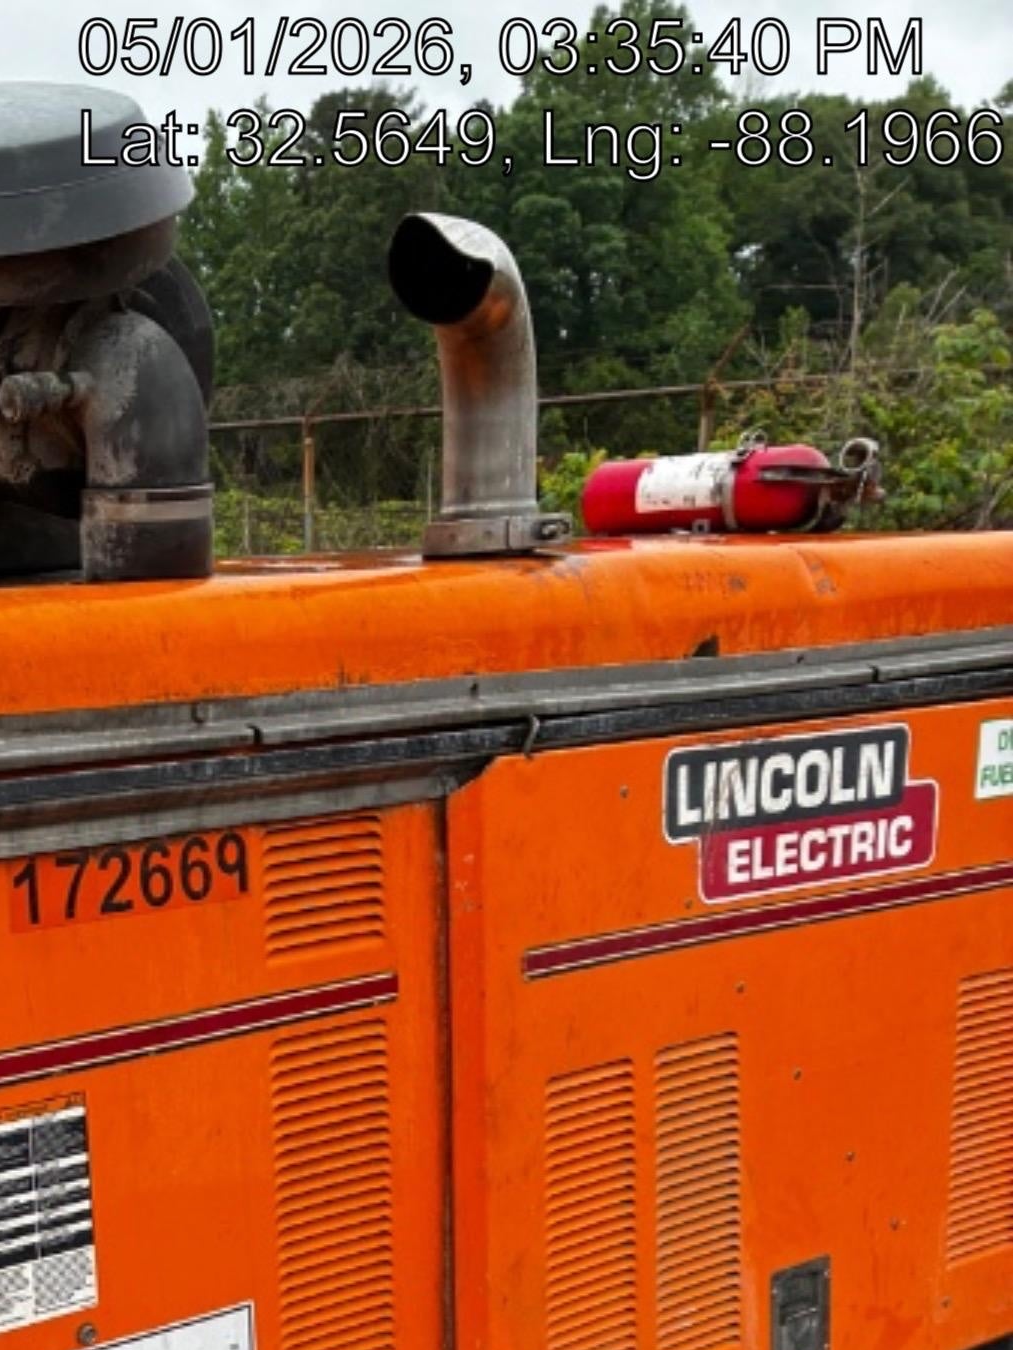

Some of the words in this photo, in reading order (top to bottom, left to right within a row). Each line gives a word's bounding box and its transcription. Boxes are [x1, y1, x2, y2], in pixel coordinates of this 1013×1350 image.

[677, 740, 896, 826] LINCOLN
[11, 832, 250, 926] 172669
[726, 815, 913, 884] ELECTRIC
